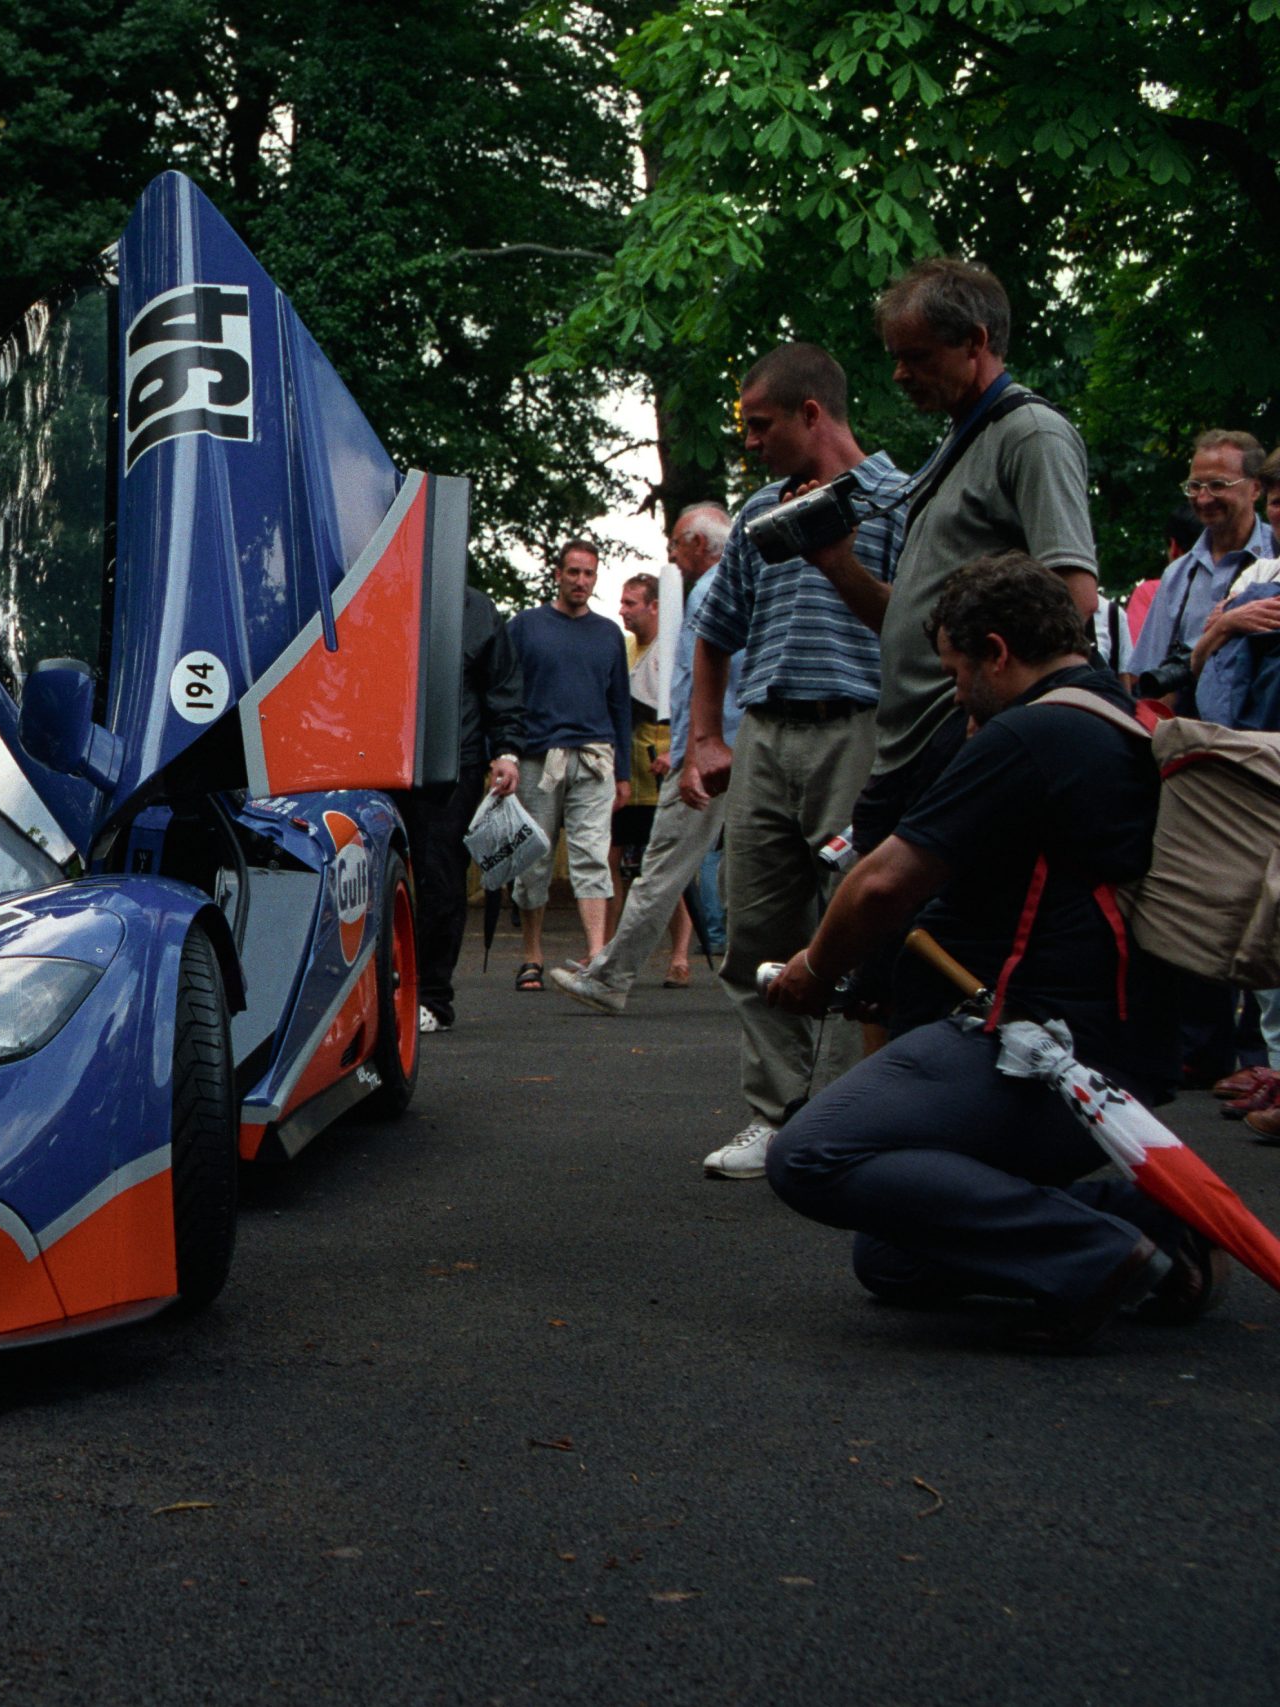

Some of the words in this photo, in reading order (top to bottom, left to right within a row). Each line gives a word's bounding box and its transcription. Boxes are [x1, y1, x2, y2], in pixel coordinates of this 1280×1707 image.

[126, 285, 251, 474] 194
[185, 662, 214, 709] 194
[338, 858, 367, 911] Gulf
